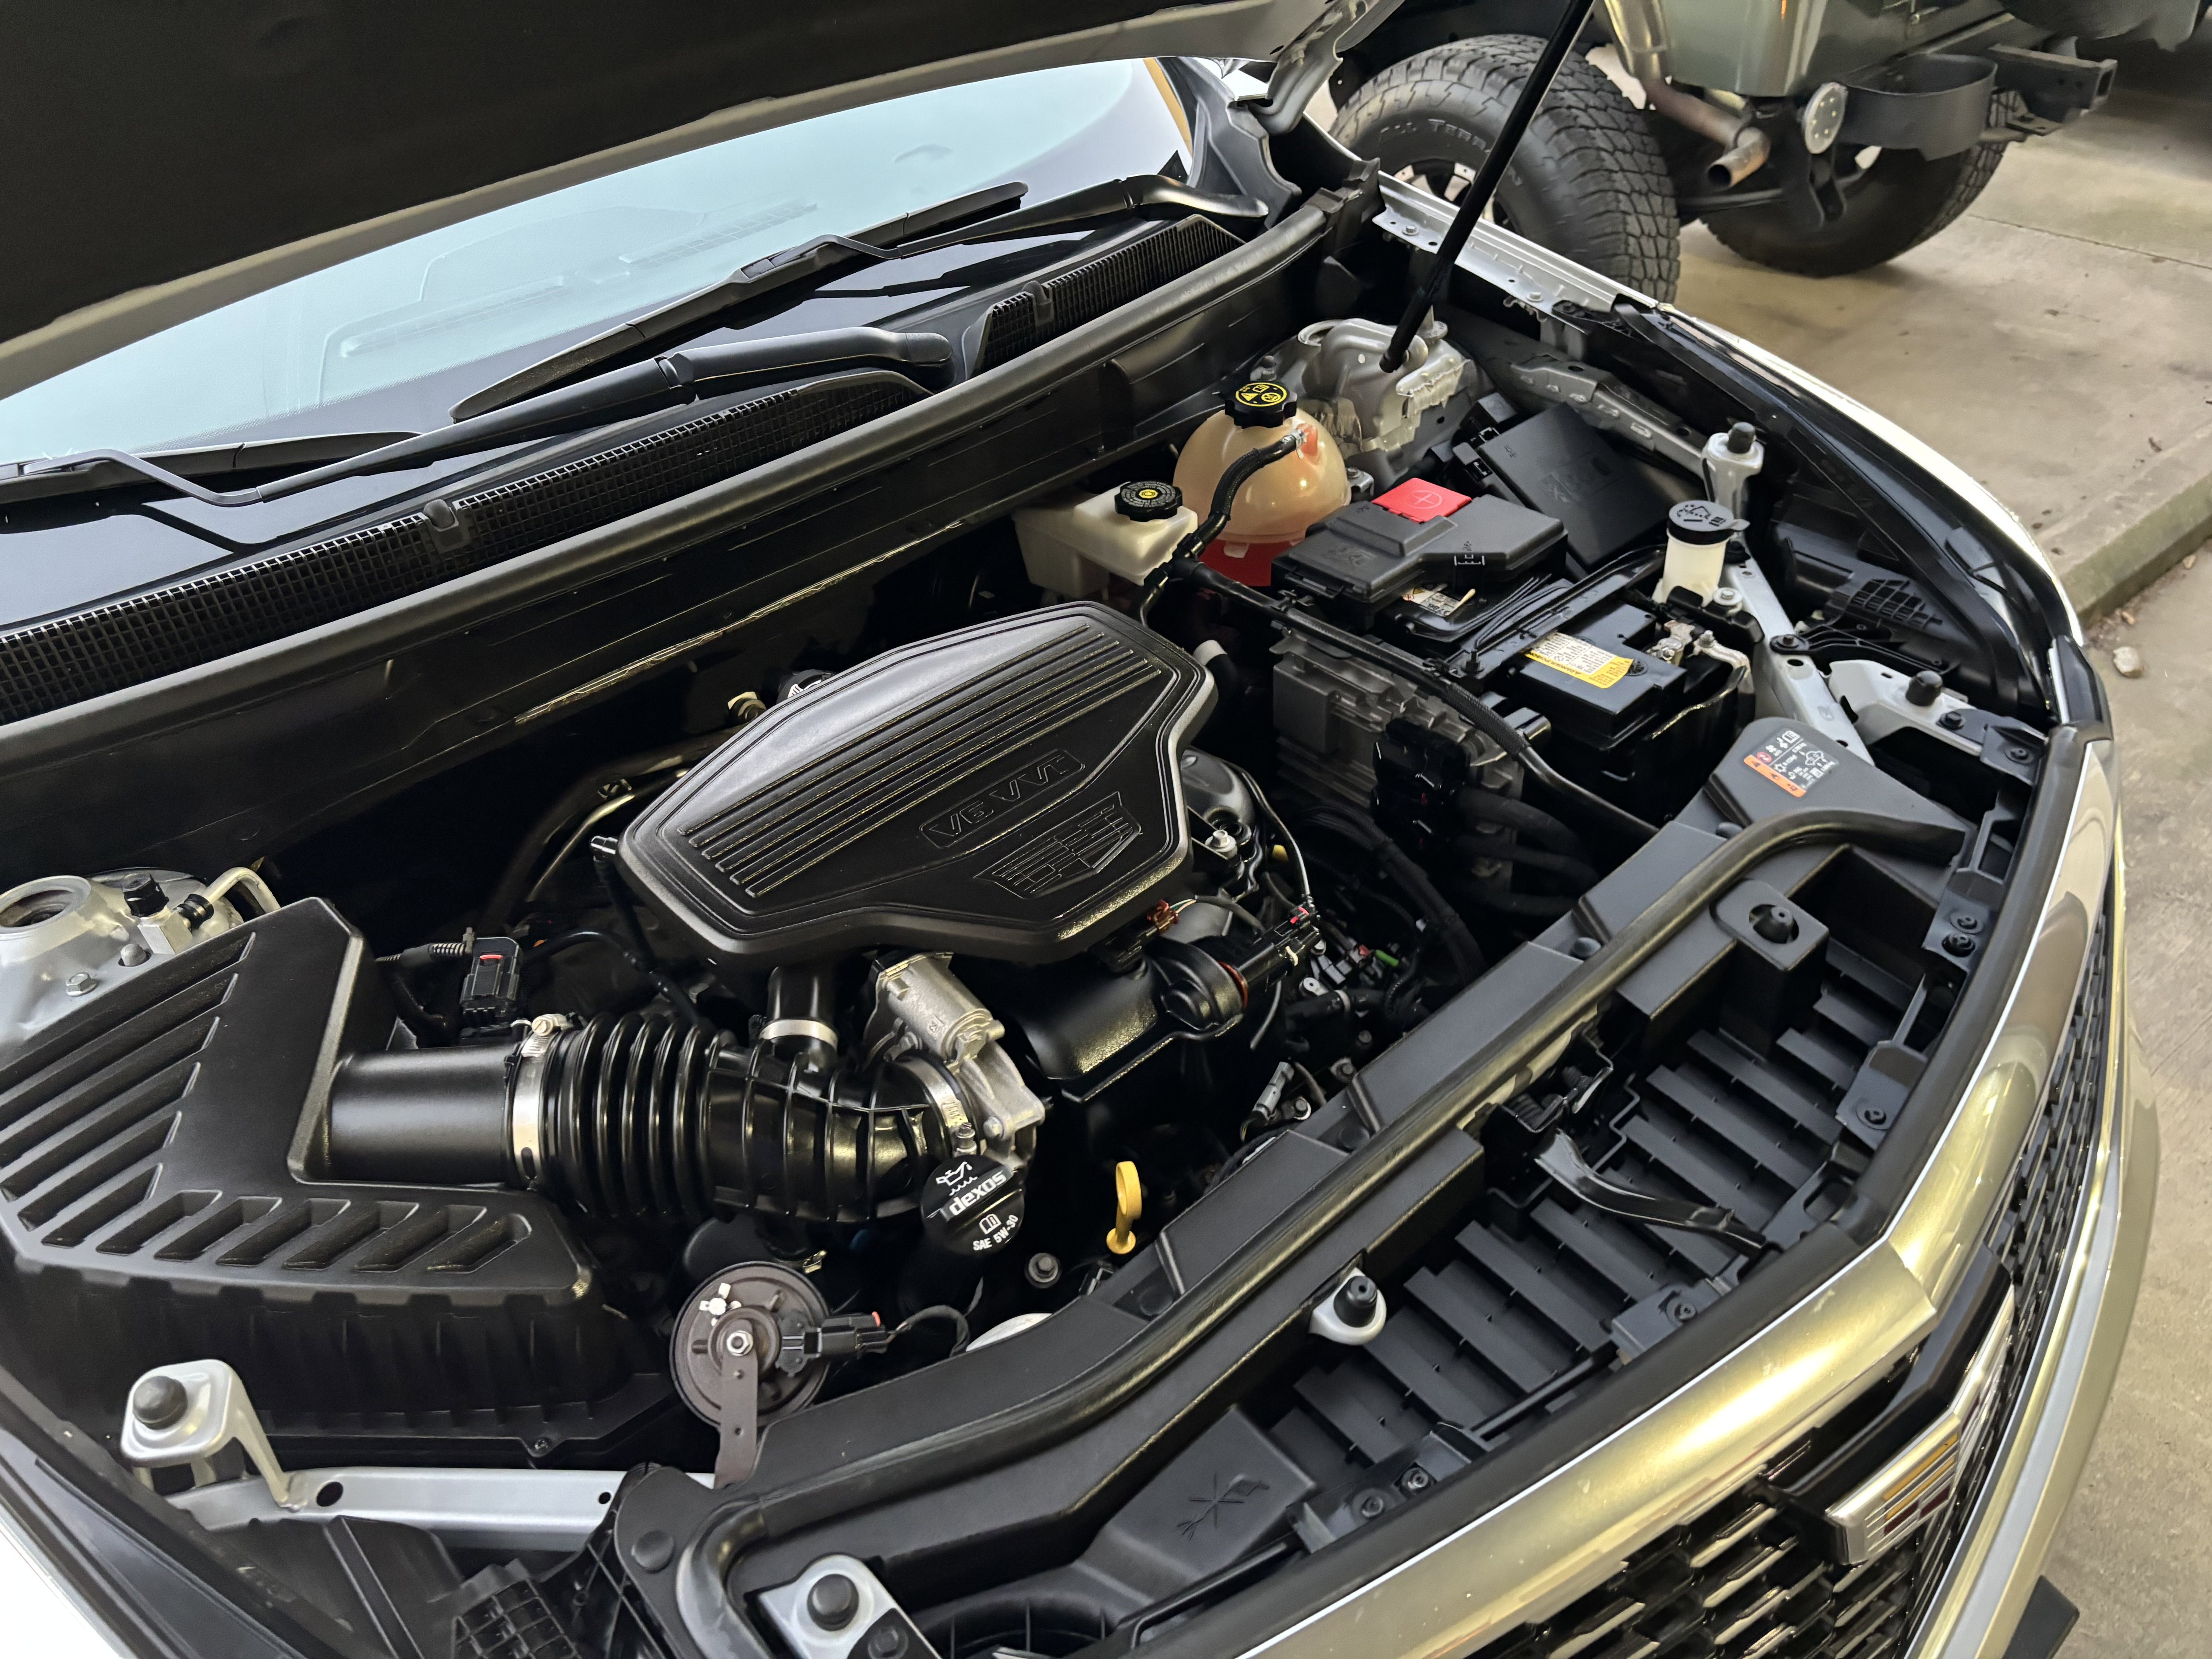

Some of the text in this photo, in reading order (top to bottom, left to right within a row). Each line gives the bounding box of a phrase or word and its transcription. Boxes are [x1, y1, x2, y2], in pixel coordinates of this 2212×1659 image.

[929, 800, 994, 836] V6
[949, 1170, 1007, 1216] dexos
[973, 1214, 1018, 1251] SAE 5W-30
